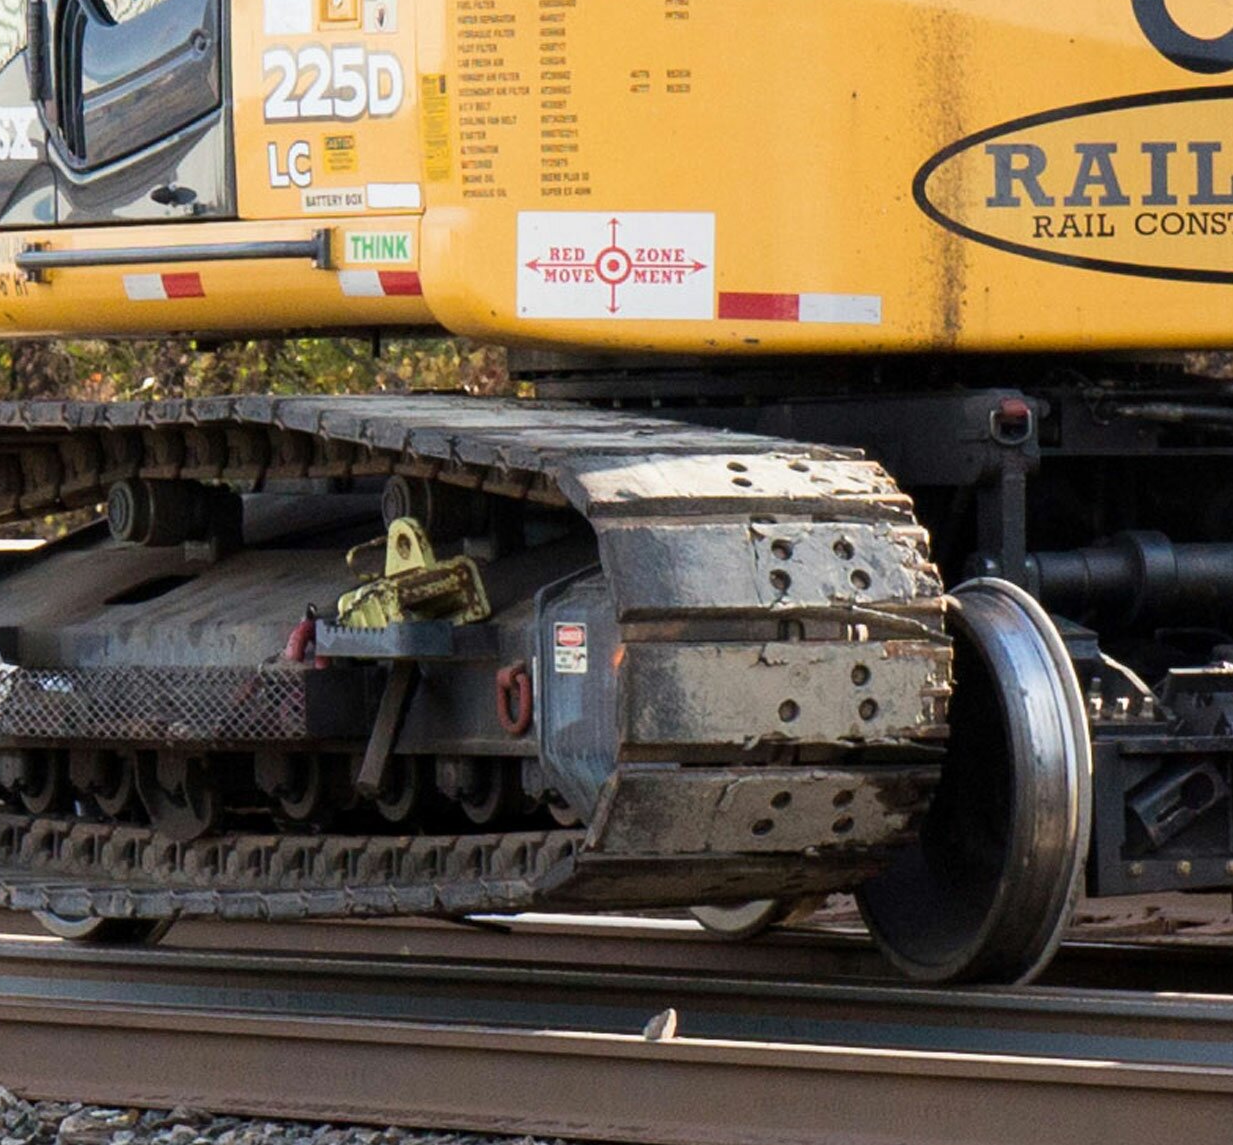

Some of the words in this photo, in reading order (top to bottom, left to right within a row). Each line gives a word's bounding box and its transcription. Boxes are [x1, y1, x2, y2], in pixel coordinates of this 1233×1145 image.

[262, 46, 404, 123] 225D
[267, 140, 312, 188] LC
[306, 194, 343, 207] BATTERY
[346, 193, 363, 205] BOX
[1033, 213, 1115, 237] RAIL
[351, 235, 408, 259] THINK
[549, 247, 585, 261] RED
[635, 248, 685, 262] ZONE
[544, 268, 595, 283] MOVE
[633, 269, 686, 284] MENT
